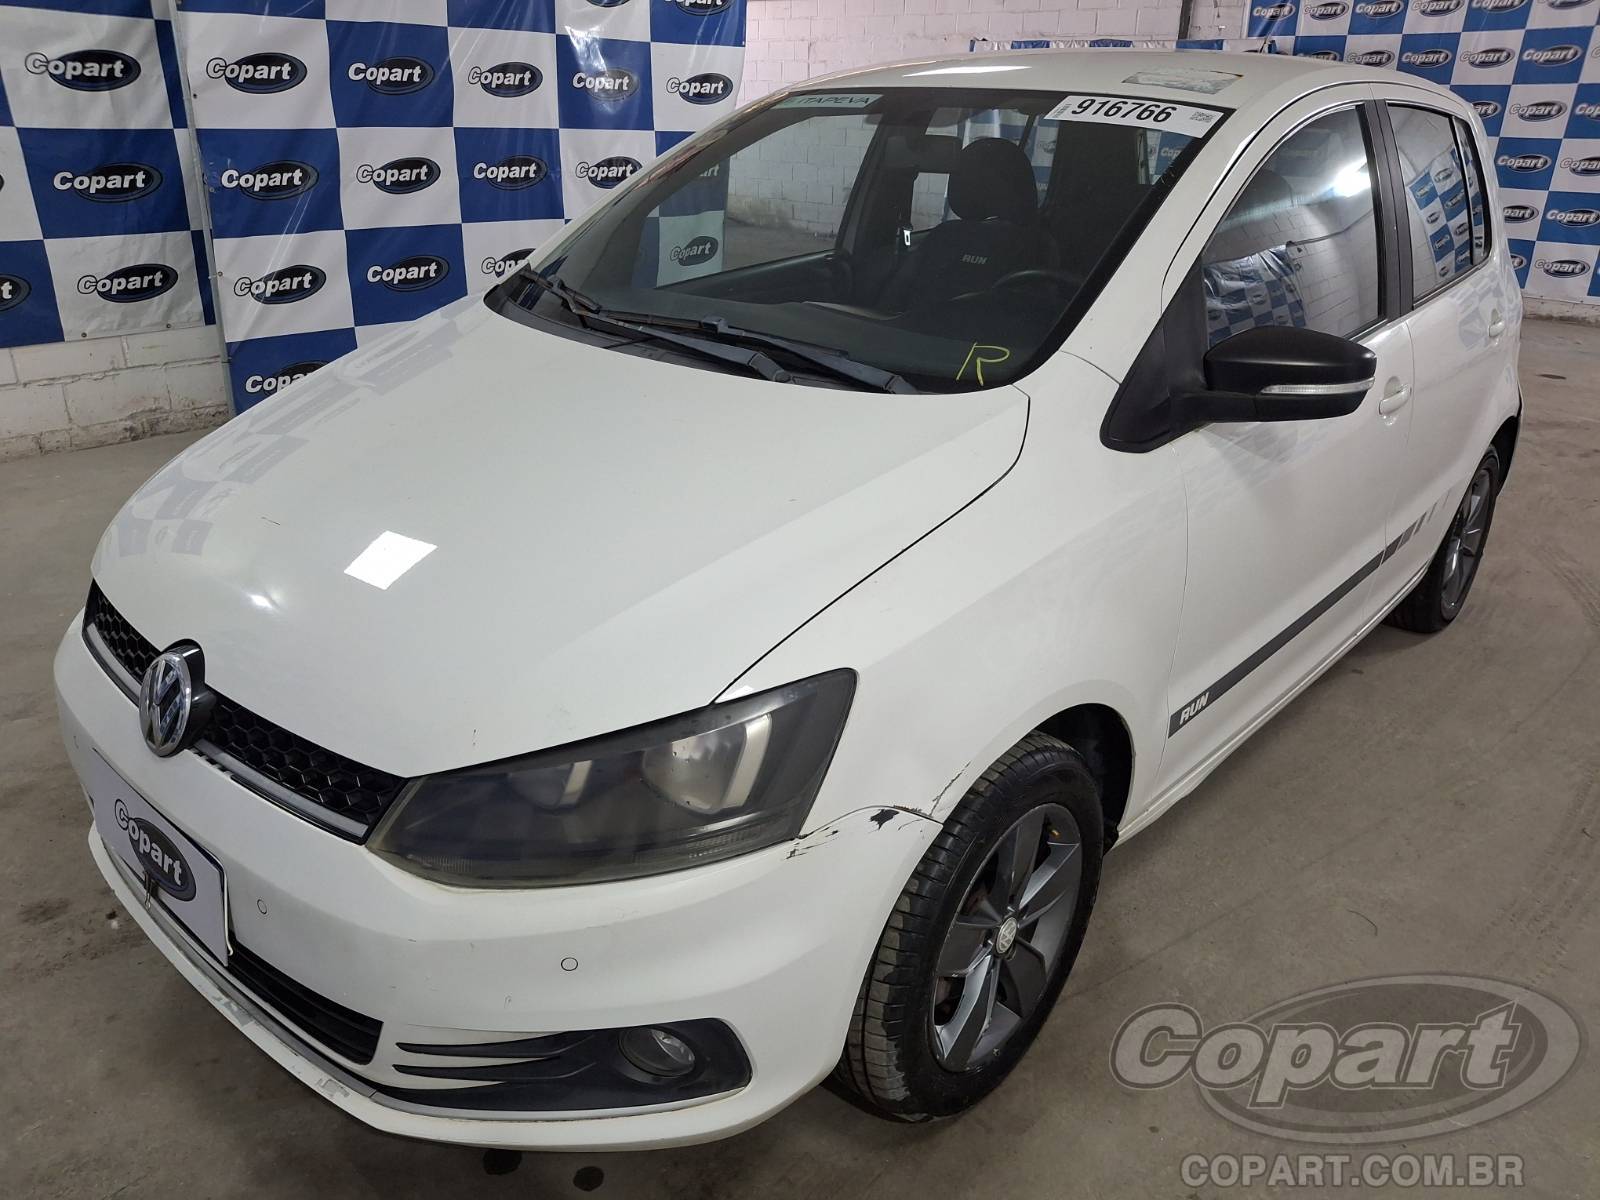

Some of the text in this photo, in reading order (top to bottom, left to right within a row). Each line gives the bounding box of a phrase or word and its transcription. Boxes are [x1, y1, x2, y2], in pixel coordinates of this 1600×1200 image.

[1253, 5, 1294, 17] Copart
[1304, 4, 1344, 17] Copart
[1356, 2, 1401, 15] Copart
[25, 52, 125, 79] Copart
[1347, 52, 1389, 64] Copart
[1402, 51, 1446, 64] Copart
[1460, 51, 1509, 65] Copart
[1522, 47, 1575, 64] Copart
[206, 57, 292, 81] Copart
[348, 62, 422, 85] Copart
[468, 66, 532, 87] Copart
[572, 72, 630, 92] Copart
[666, 77, 725, 97] Copart
[1071, 98, 1177, 123] 916766
[1509, 103, 1560, 118] Copart
[473, 161, 538, 180] Copart
[575, 160, 634, 182] Copart
[1497, 155, 1546, 169] Copart
[53, 170, 147, 194] Copart
[220, 168, 303, 192] Copart
[356, 164, 429, 186] Copart
[1503, 207, 1532, 219] part
[1546, 209, 1598, 223] Copart
[670, 241, 712, 263] Copart
[962, 254, 988, 265] RUN
[367, 260, 439, 285] Copart
[1535, 258, 1583, 273] Copart
[77, 270, 164, 295] Copart
[234, 271, 313, 297] Copart
[956, 342, 1011, 387] R
[1179, 691, 1210, 726] RUN
[114, 798, 183, 887] Copart
